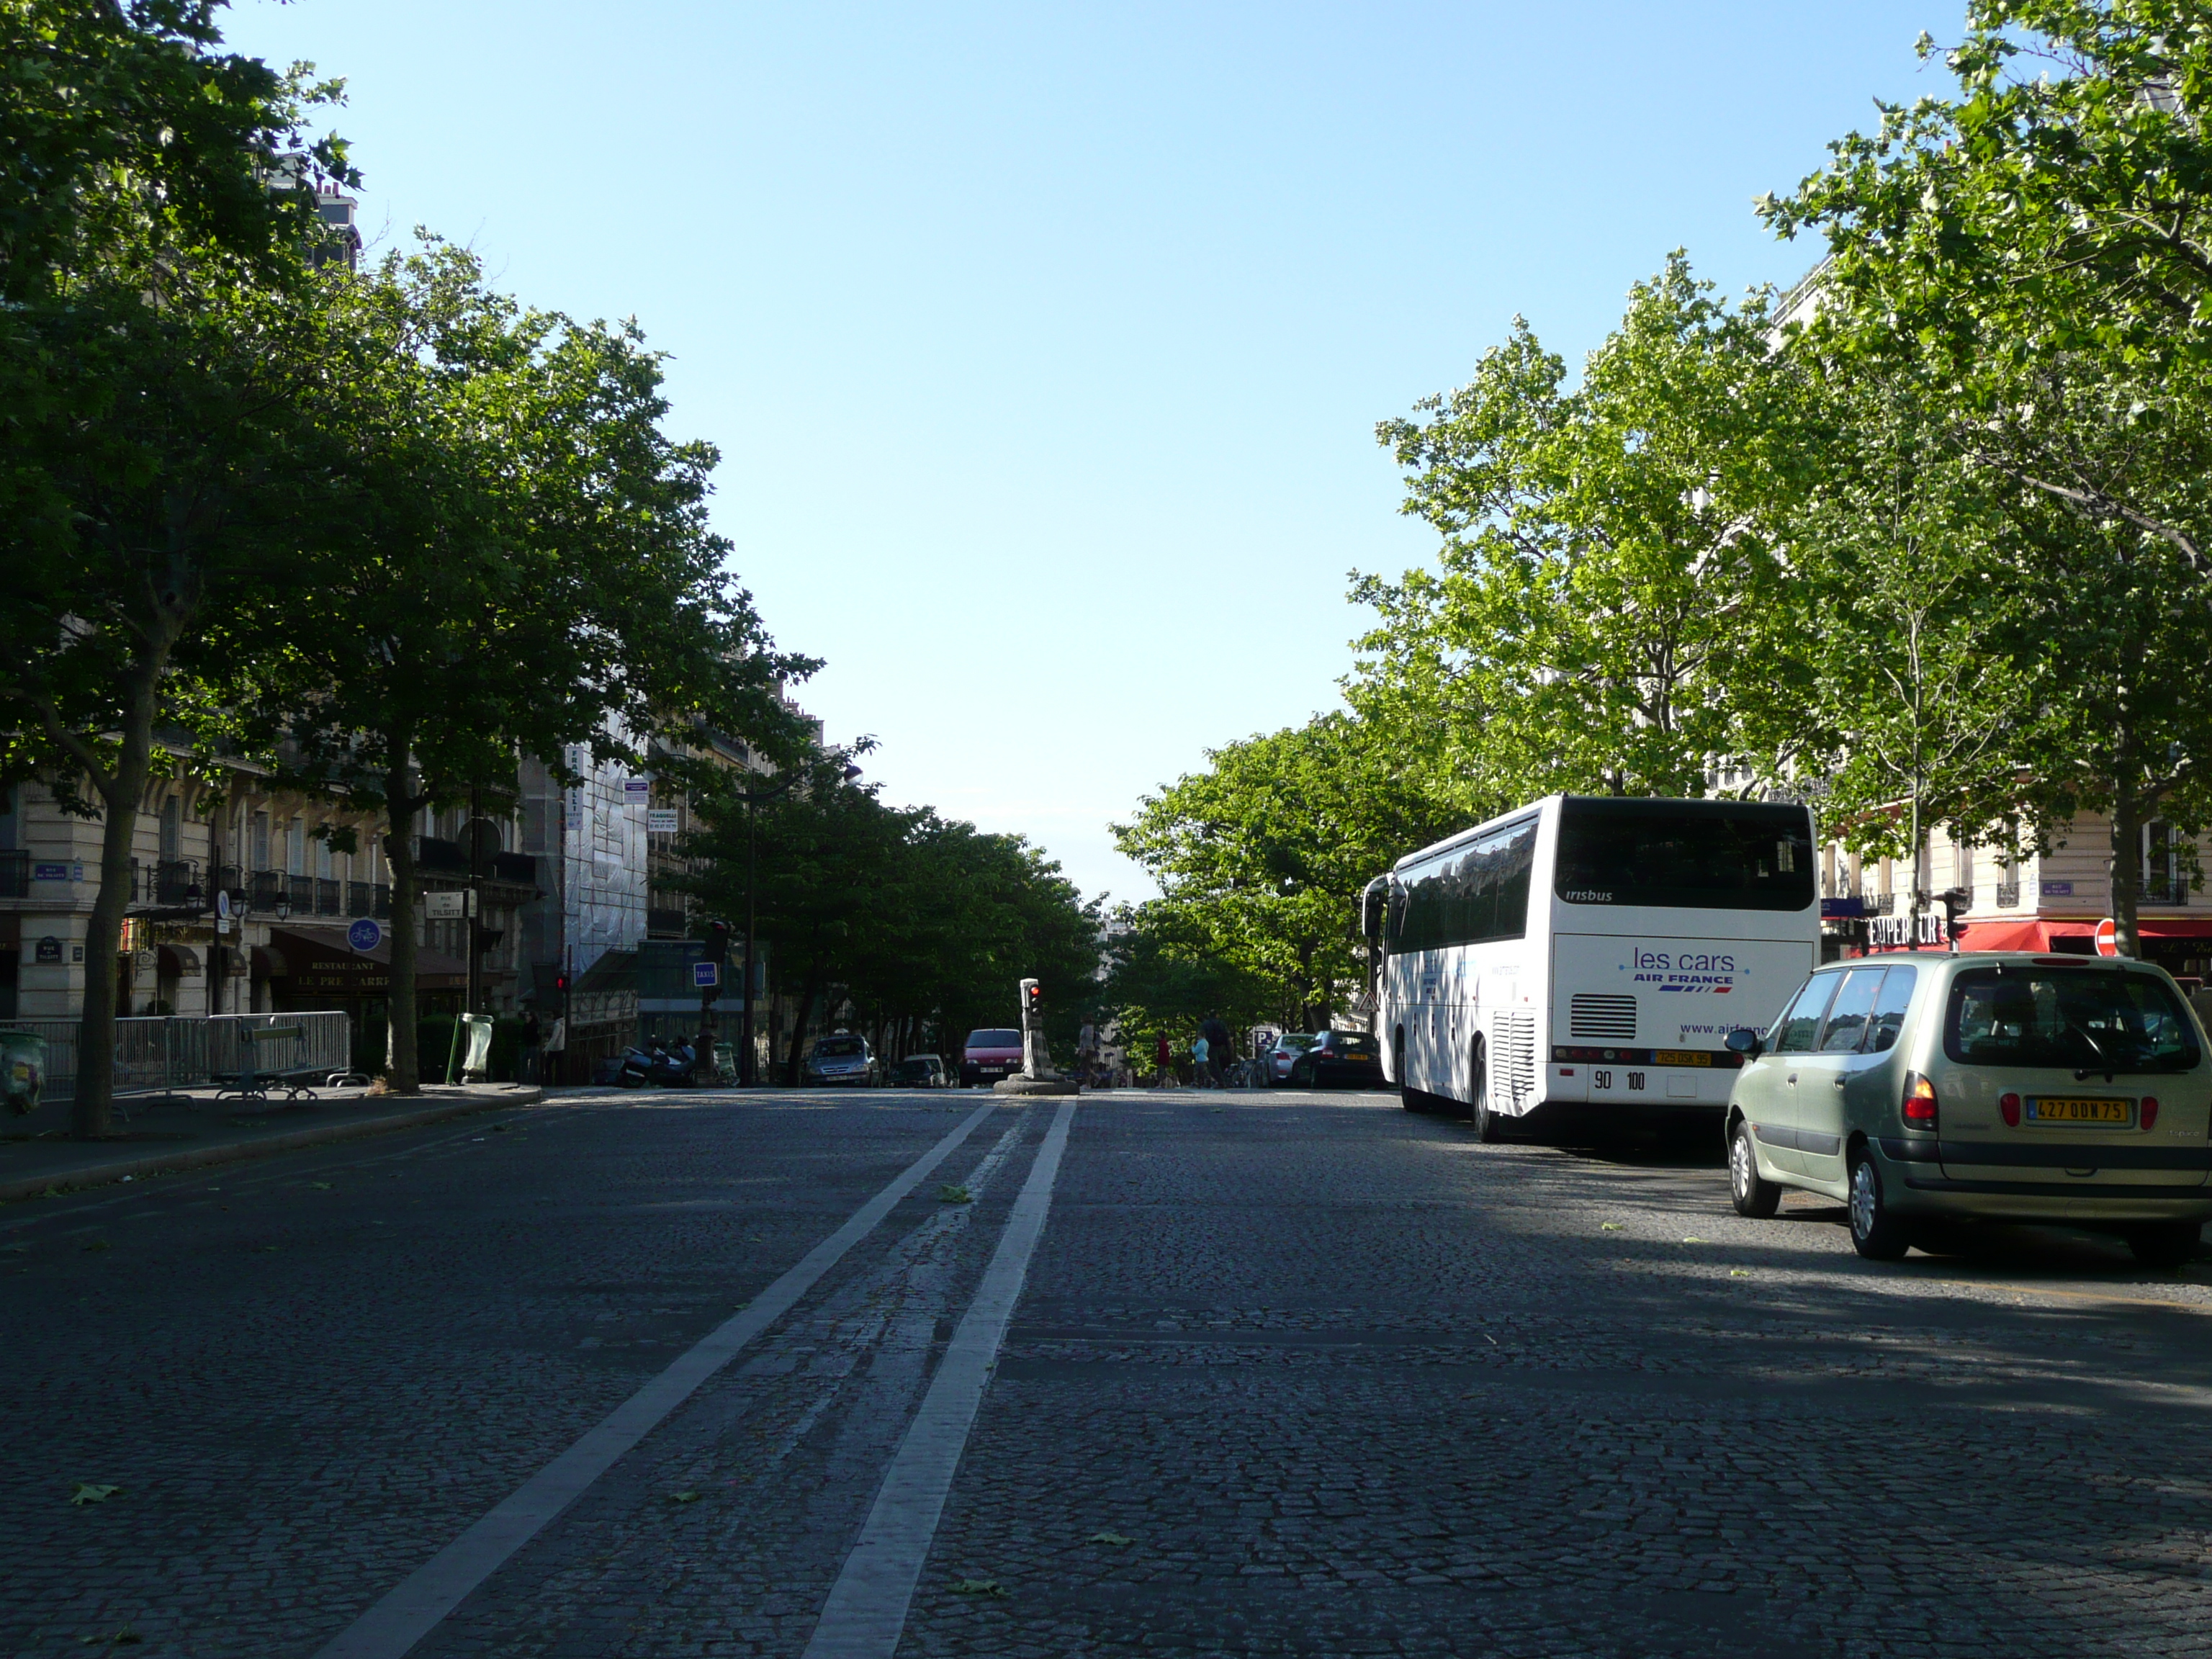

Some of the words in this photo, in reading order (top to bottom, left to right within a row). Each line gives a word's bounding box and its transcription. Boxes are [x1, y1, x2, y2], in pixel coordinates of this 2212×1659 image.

[1869, 914, 1937, 945] EMPERUR
[1635, 947, 1671, 970] les
[1678, 953, 1735, 971] cars
[312, 962, 374, 971] RESTAUANT
[298, 976, 314, 986] LE
[1634, 974, 1663, 982] AIR
[1668, 974, 1734, 984] FRANCE
[1258, 1032, 1267, 1043] P
[1659, 1052, 1676, 1062] 725
[1696, 1054, 1708, 1064] 95
[1594, 1070, 1612, 1089] 90
[1627, 1071, 1645, 1090] 100
[2038, 1102, 2065, 1118] 427
[2103, 1104, 2121, 1119] 75
